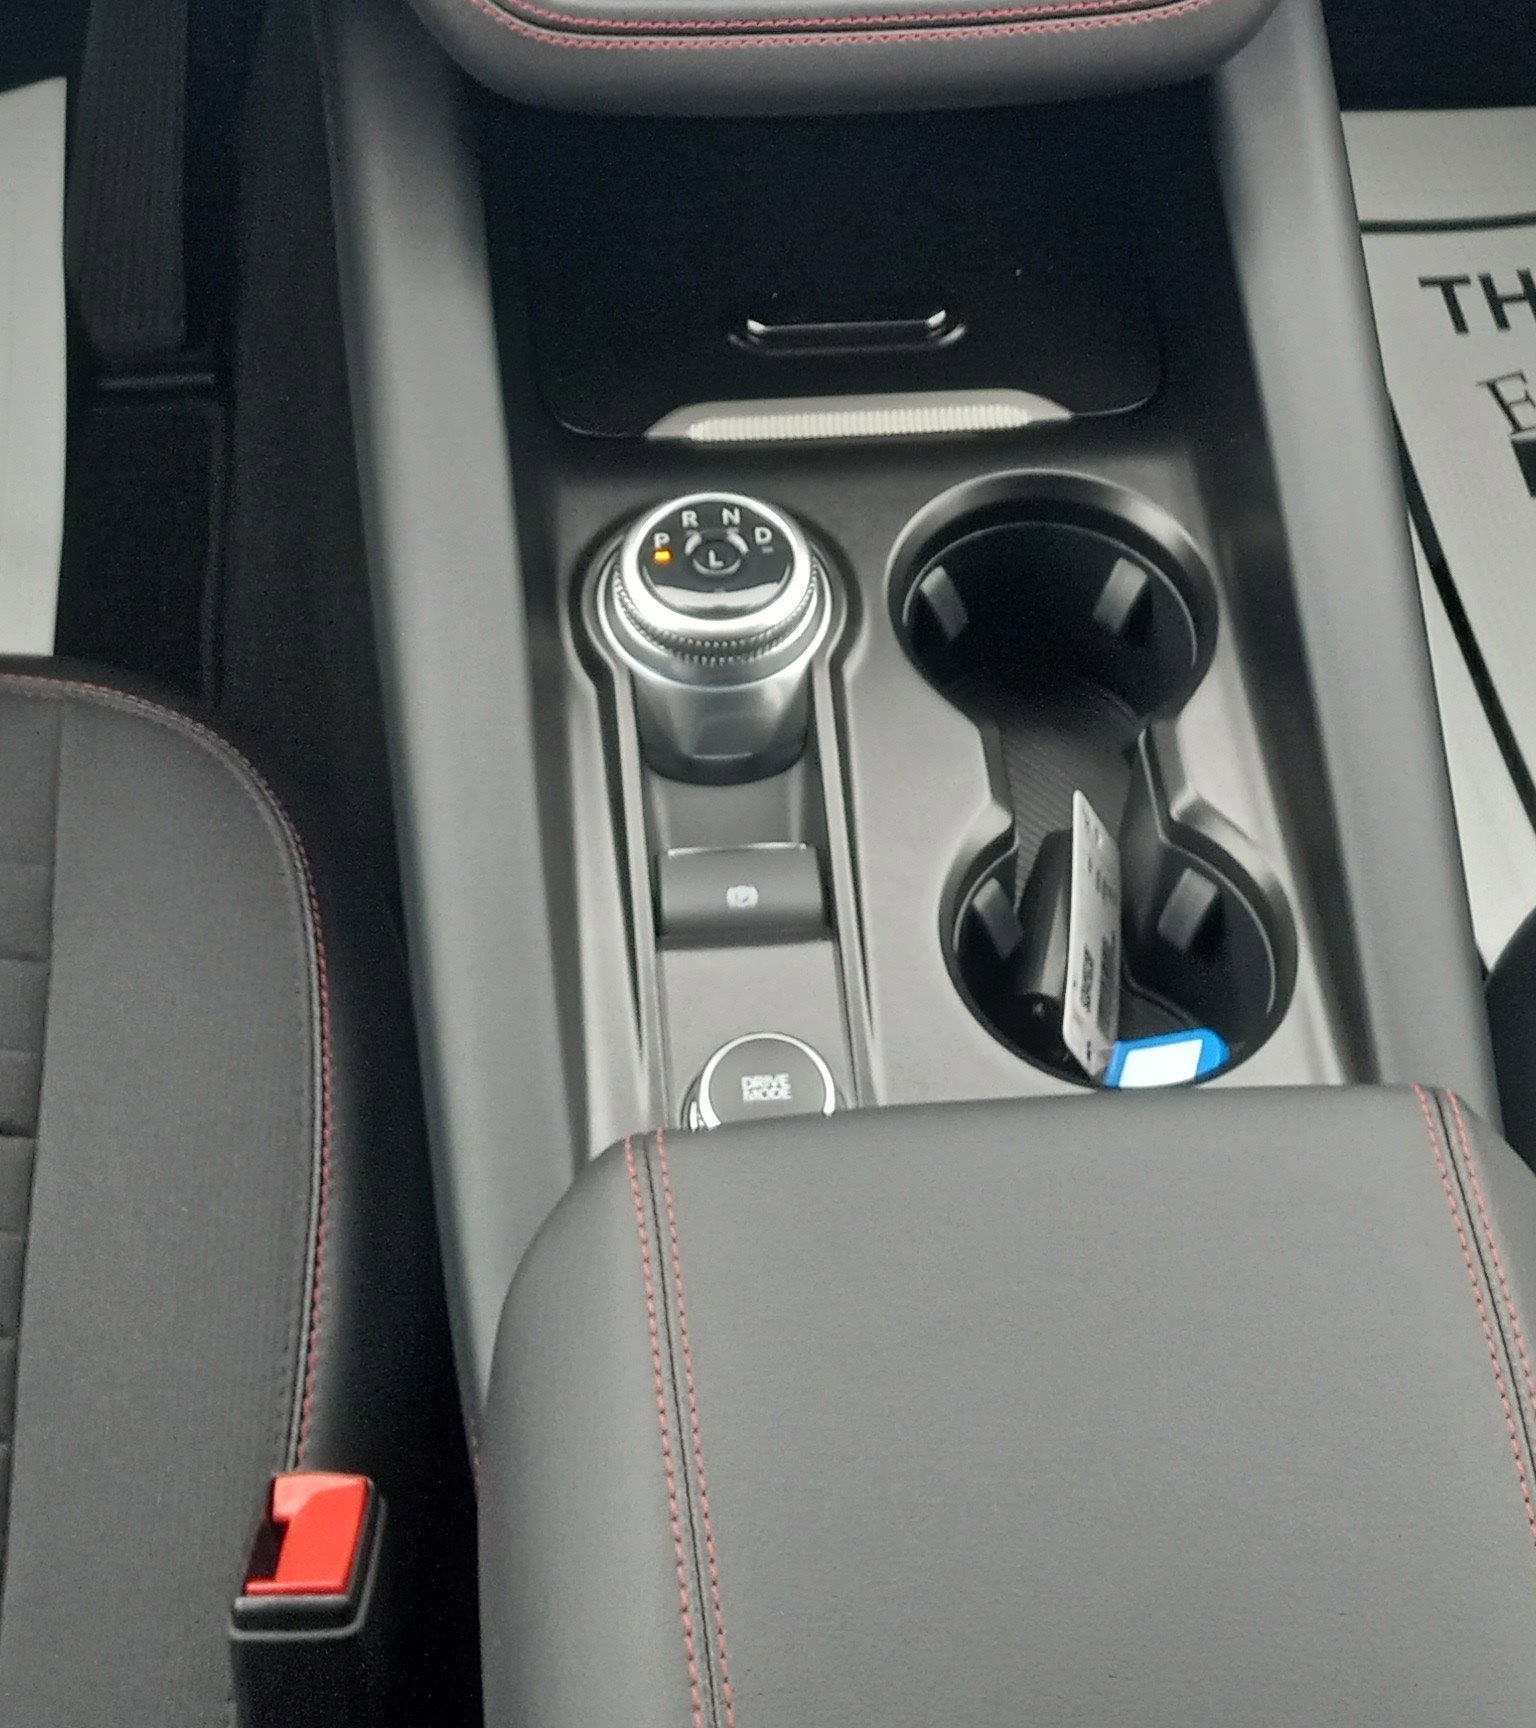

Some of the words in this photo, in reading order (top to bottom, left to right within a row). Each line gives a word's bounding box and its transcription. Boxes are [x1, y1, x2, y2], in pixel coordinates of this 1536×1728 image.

[681, 510, 699, 528] R
[721, 507, 741, 526] N
[653, 532, 671, 549] P
[754, 526, 773, 545] D
[708, 549, 724, 568] L
[740, 1073, 791, 1089] DRIVE
